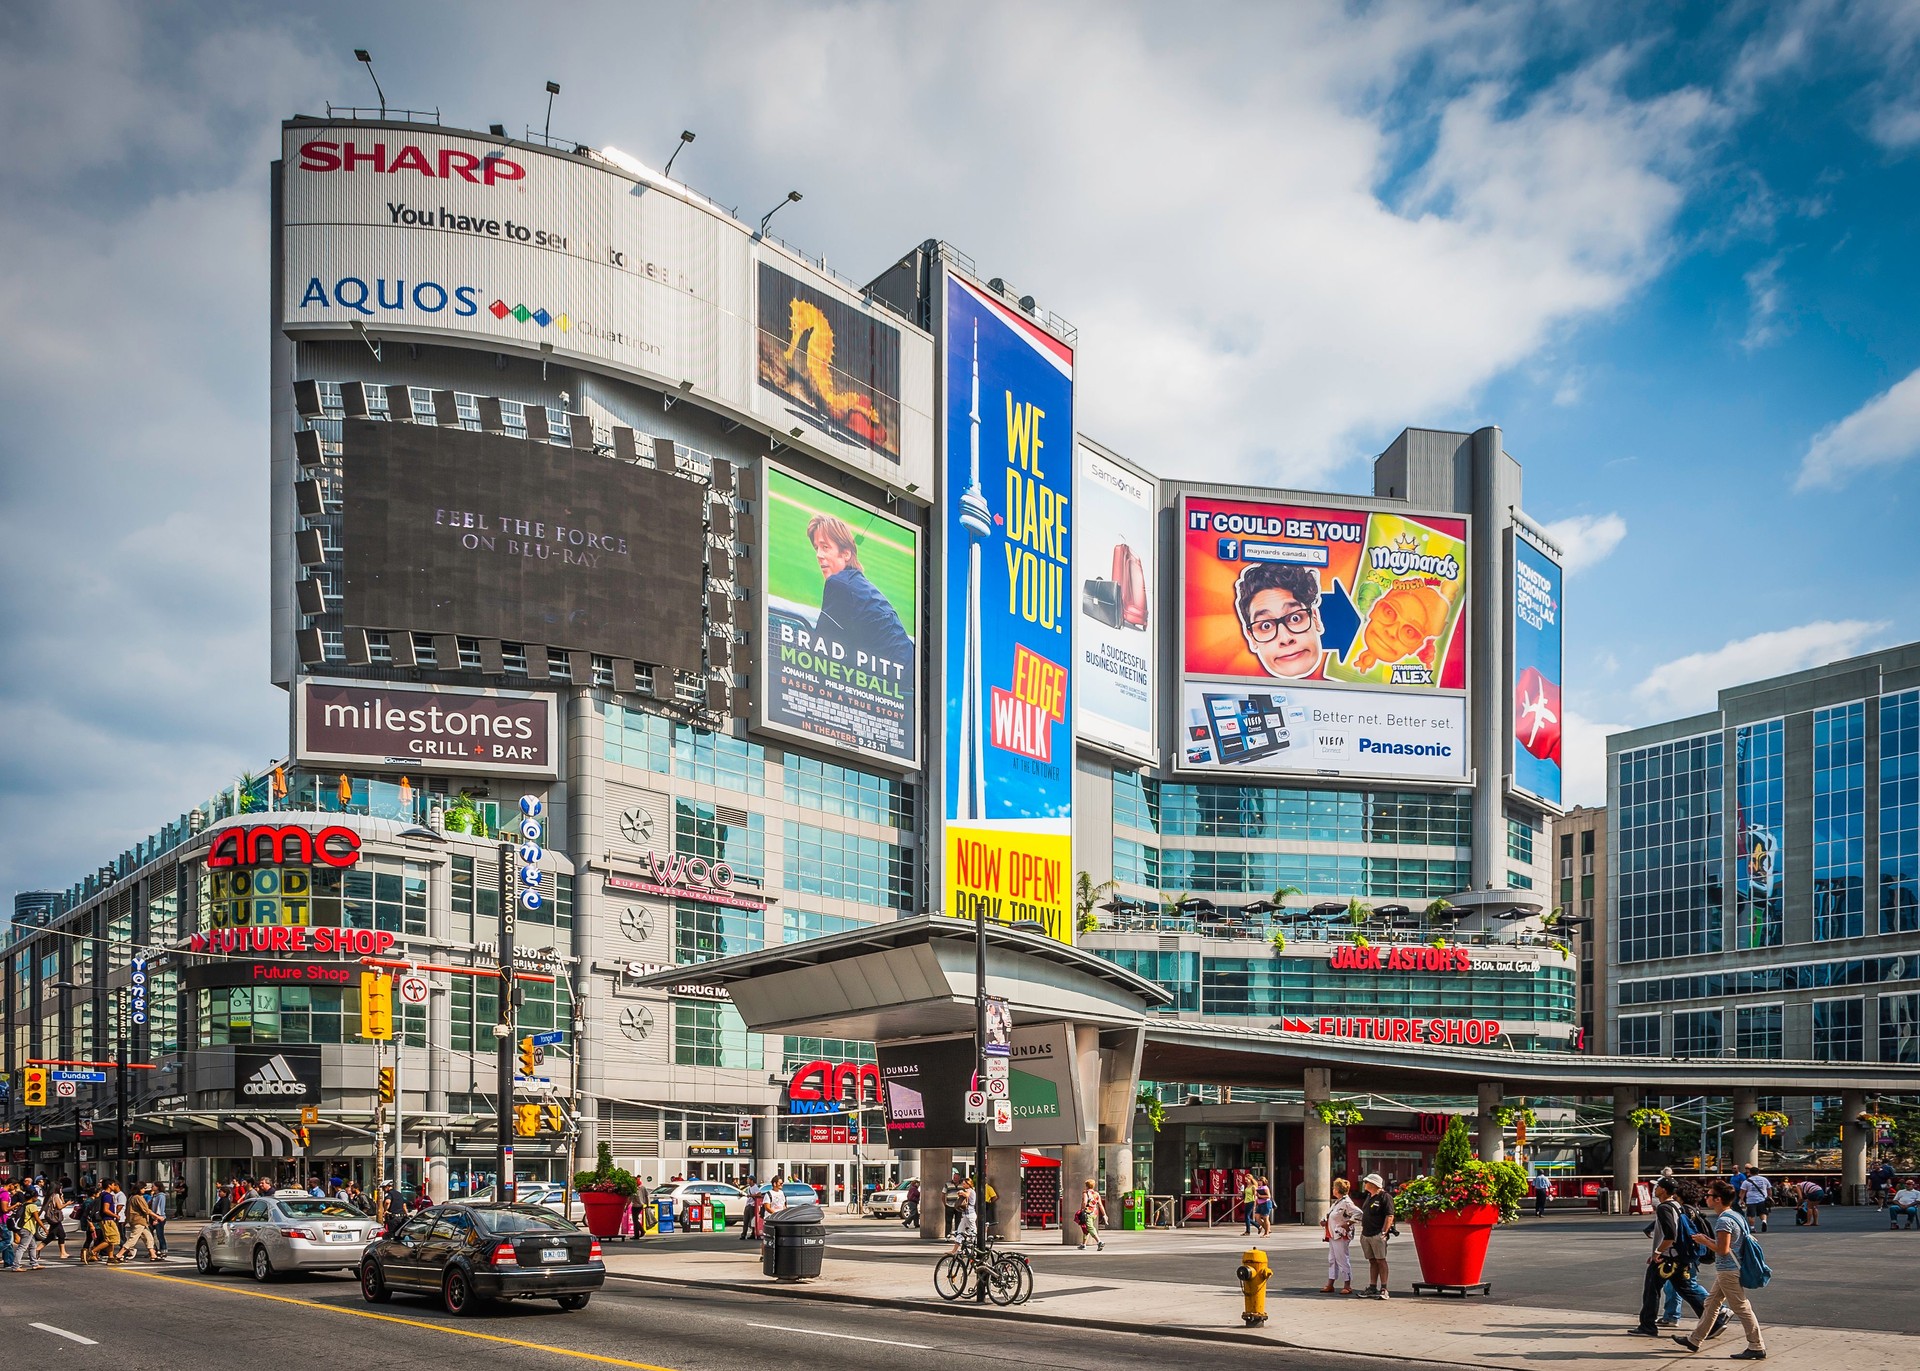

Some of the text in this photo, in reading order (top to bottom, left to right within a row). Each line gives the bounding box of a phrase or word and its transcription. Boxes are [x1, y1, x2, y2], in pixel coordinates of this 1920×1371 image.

[299, 141, 526, 186] SHARP
[387, 202, 435, 227] You
[439, 206, 500, 236] have
[504, 219, 531, 242] to
[299, 277, 478, 316] AQUOS
[1005, 389, 1046, 480] WE
[1091, 463, 1141, 499] Samsonite
[1006, 467, 1068, 564] DARE
[1189, 512, 1362, 542] IT COULD BE YOU!
[435, 508, 628, 555] FEEL THE FORCE
[462, 534, 601, 568] ON BLU-RAY
[1247, 548, 1307, 558] maynards canada
[1005, 541, 1063, 634] YOU!
[1392, 578, 1424, 590] PATCH
[1517, 560, 1551, 592] NONSTOP
[1517, 574, 1551, 608] TORONTO
[1518, 589, 1531, 609] SFO
[1540, 605, 1554, 625] LAX
[781, 624, 904, 680] BRAD PITT
[1101, 642, 1147, 672] A SUCCESSFUL
[781, 645, 904, 700] MONEYBALL
[1086, 650, 1147, 685] BUSINESS MEETING
[1391, 671, 1432, 683] ALEX
[781, 677, 814, 692] BASED
[819, 689, 832, 698] ON
[848, 698, 871, 711] TRUE
[876, 707, 904, 720] STORY
[782, 665, 904, 710] JONAH HILL PHILIP SEYMOUR HOFFMAN
[1015, 650, 1064, 718] EDGE
[324, 698, 532, 740] milestones
[994, 692, 1047, 759] WALK
[1313, 709, 1454, 729] Better net. Better set.
[409, 739, 468, 756] GRILL
[492, 744, 533, 759] BAR
[802, 721, 811, 730] IN
[814, 724, 856, 743] THEATERS
[858, 737, 886, 752] 9.23.11
[1359, 738, 1451, 757] Panasonic
[1013, 757, 1020, 769] AT
[1021, 759, 1030, 774] THE
[214, 870, 308, 897] FOOD
[957, 837, 1061, 905] NOW OPEN!
[505, 852, 514, 933] DOWNTOWN
[615, 879, 764, 909] BUFFET RESTAURANT LOUNGE
[1010, 901, 1062, 941] TODAY!
[210, 927, 394, 954] FUTURE SHOP
[545, 963, 562, 971] BAR
[1331, 946, 1472, 971] JACK ASTOR'S
[1472, 959, 1540, 972] Bar and Grill
[254, 965, 349, 983] Future Shop
[679, 985, 713, 996] DRUG
[1318, 1017, 1500, 1045] FUTURE SHOP
[1010, 1044, 1052, 1056] UNDAS
[886, 1065, 918, 1074] DUNDAS
[243, 1080, 306, 1095] adidas
[791, 1101, 840, 1114] IMAX
[894, 1109, 921, 1117] SQUARE
[1013, 1104, 1057, 1116] SQUARE
